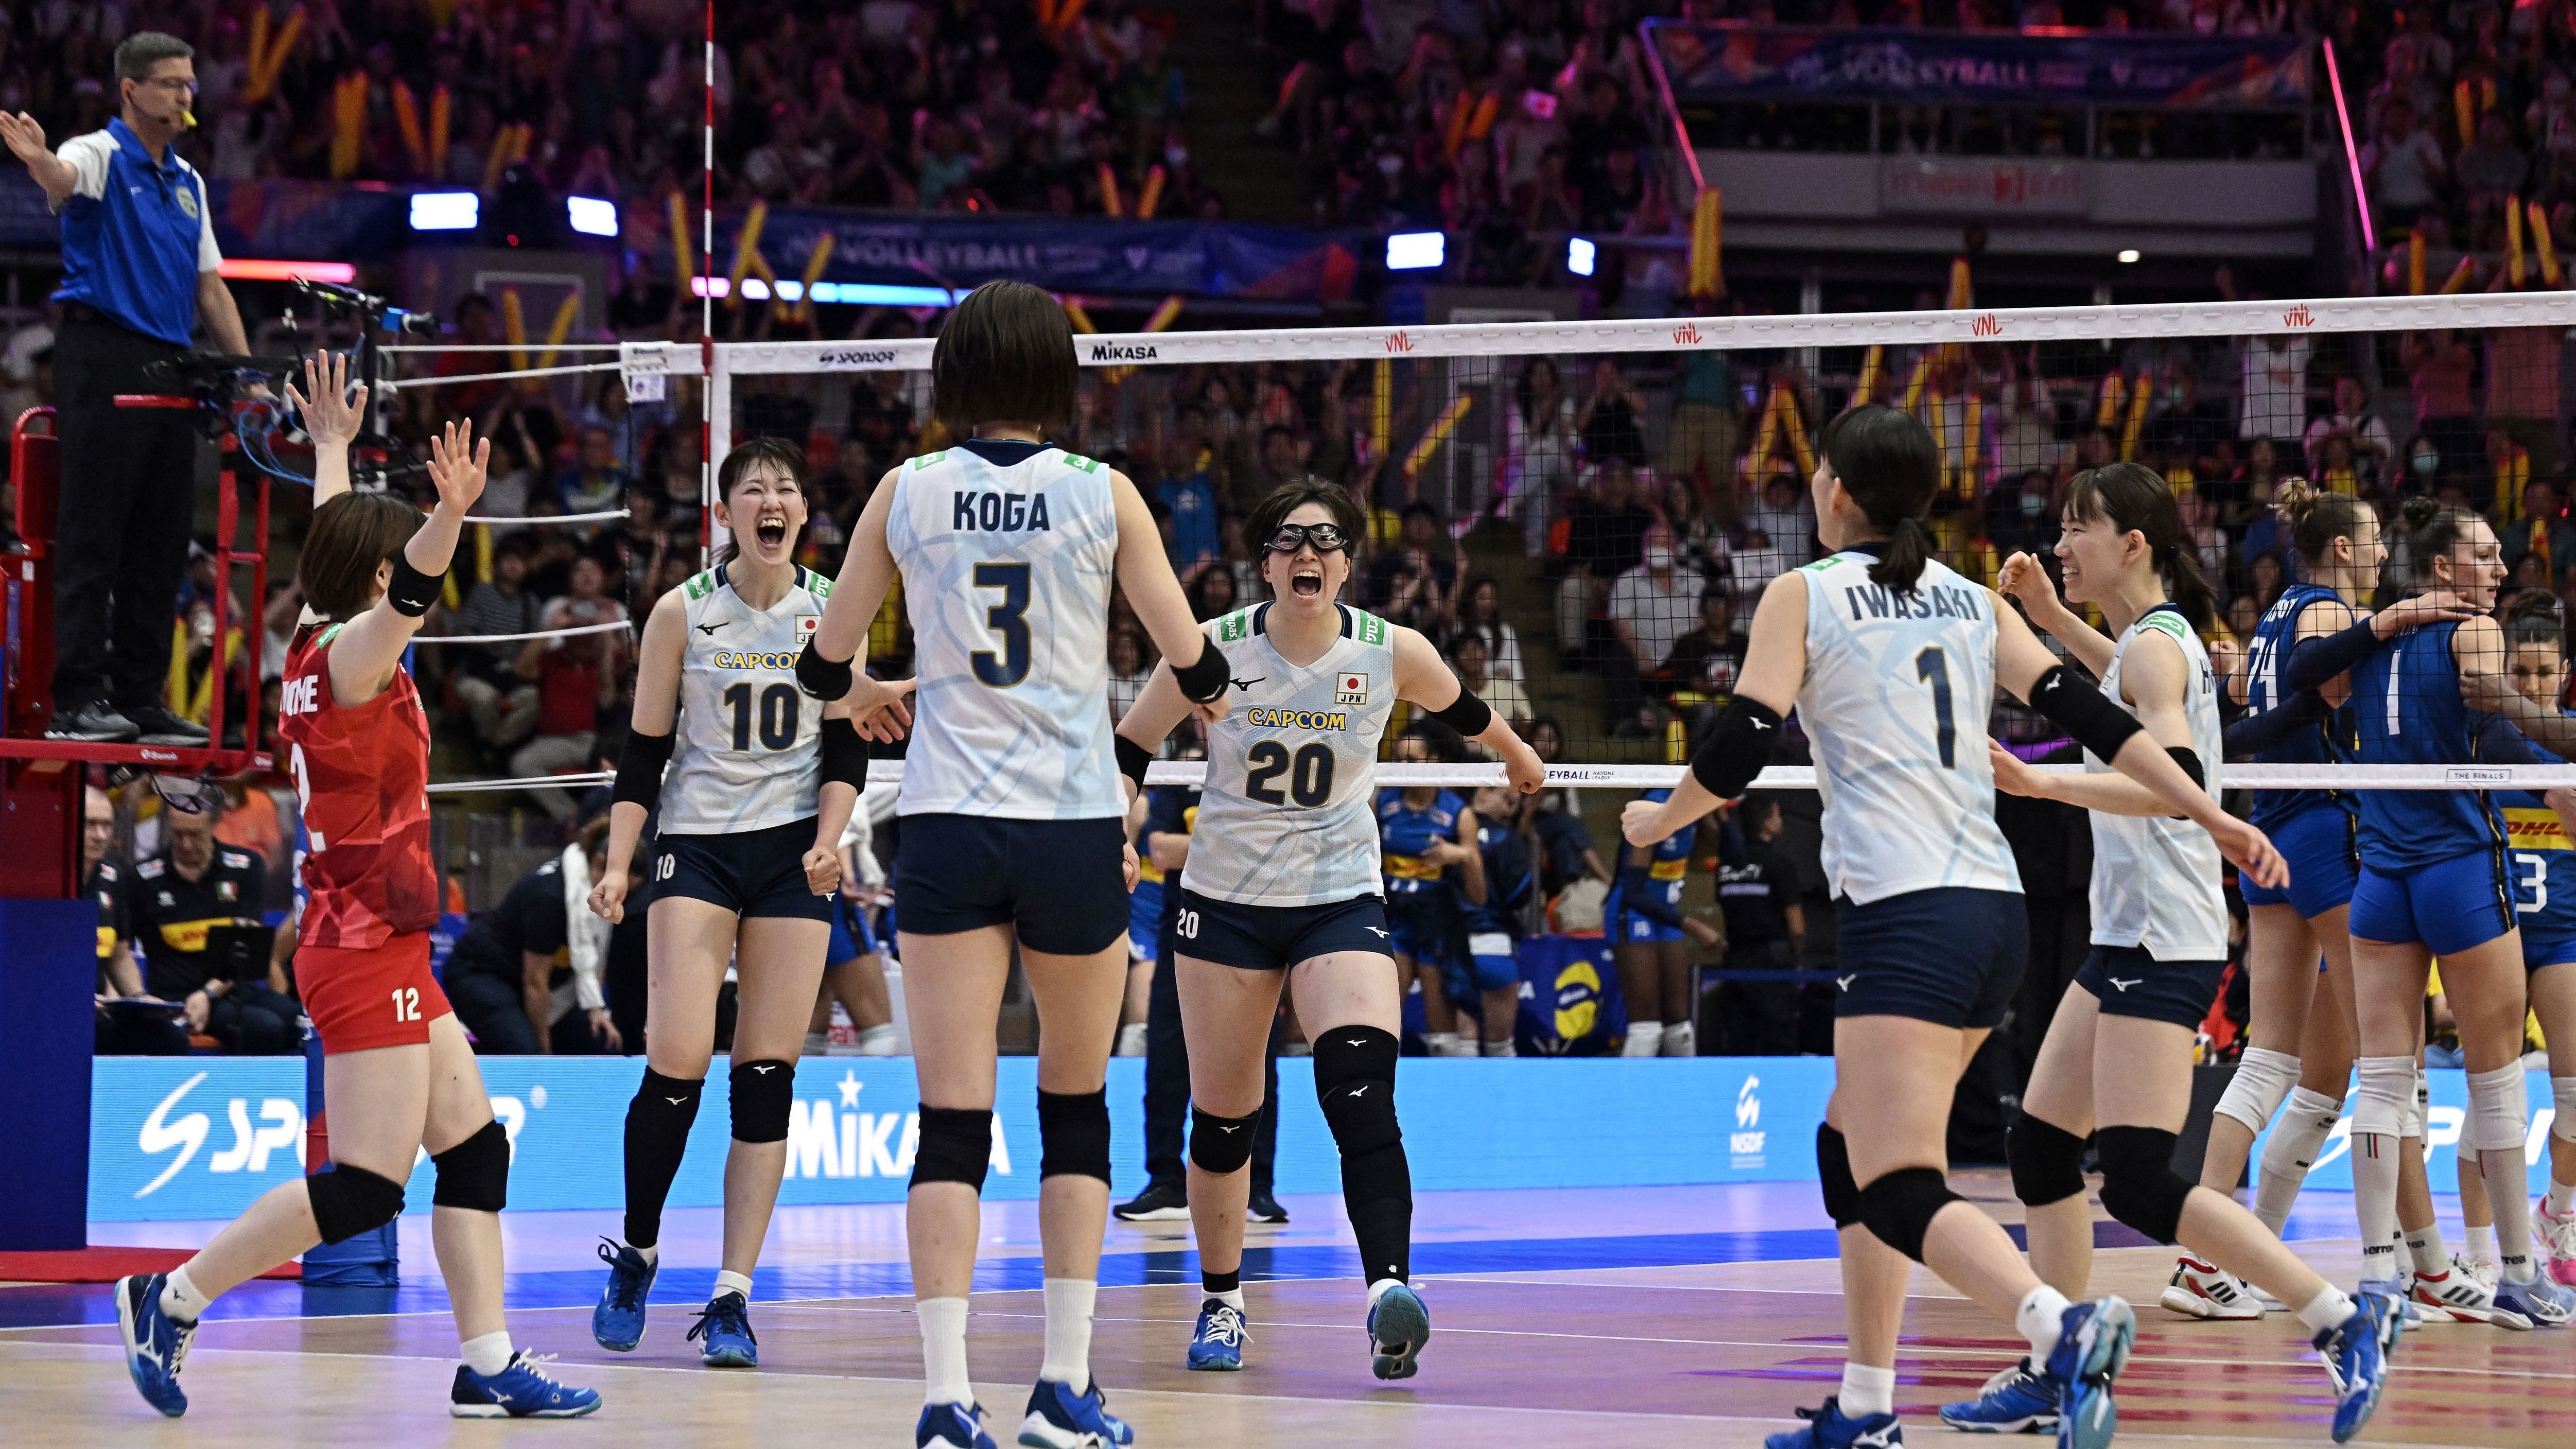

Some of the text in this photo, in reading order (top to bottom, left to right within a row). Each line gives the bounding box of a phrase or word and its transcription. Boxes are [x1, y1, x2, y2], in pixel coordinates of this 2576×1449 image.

[1972, 310, 2003, 336] VNL
[2283, 303, 2314, 326] VNL
[1385, 330, 1414, 352] VNL
[1673, 322, 1702, 344] VNL
[953, 492, 1050, 532] KOGA
[1845, 584, 1981, 621] IWASAKI
[971, 562, 1031, 689] 3
[1341, 694, 1361, 703] JPN
[1916, 646, 1956, 770] 1
[2387, 649, 2402, 736] 1
[724, 682, 799, 751] 10
[1248, 708, 1347, 732] CAPCOM
[1245, 740, 1335, 809] 20
[2507, 821, 2564, 835] DHL
[656, 853, 675, 881] 10
[2516, 853, 2547, 913] 3
[1177, 907, 1199, 938] 20
[392, 987, 422, 1023] 12
